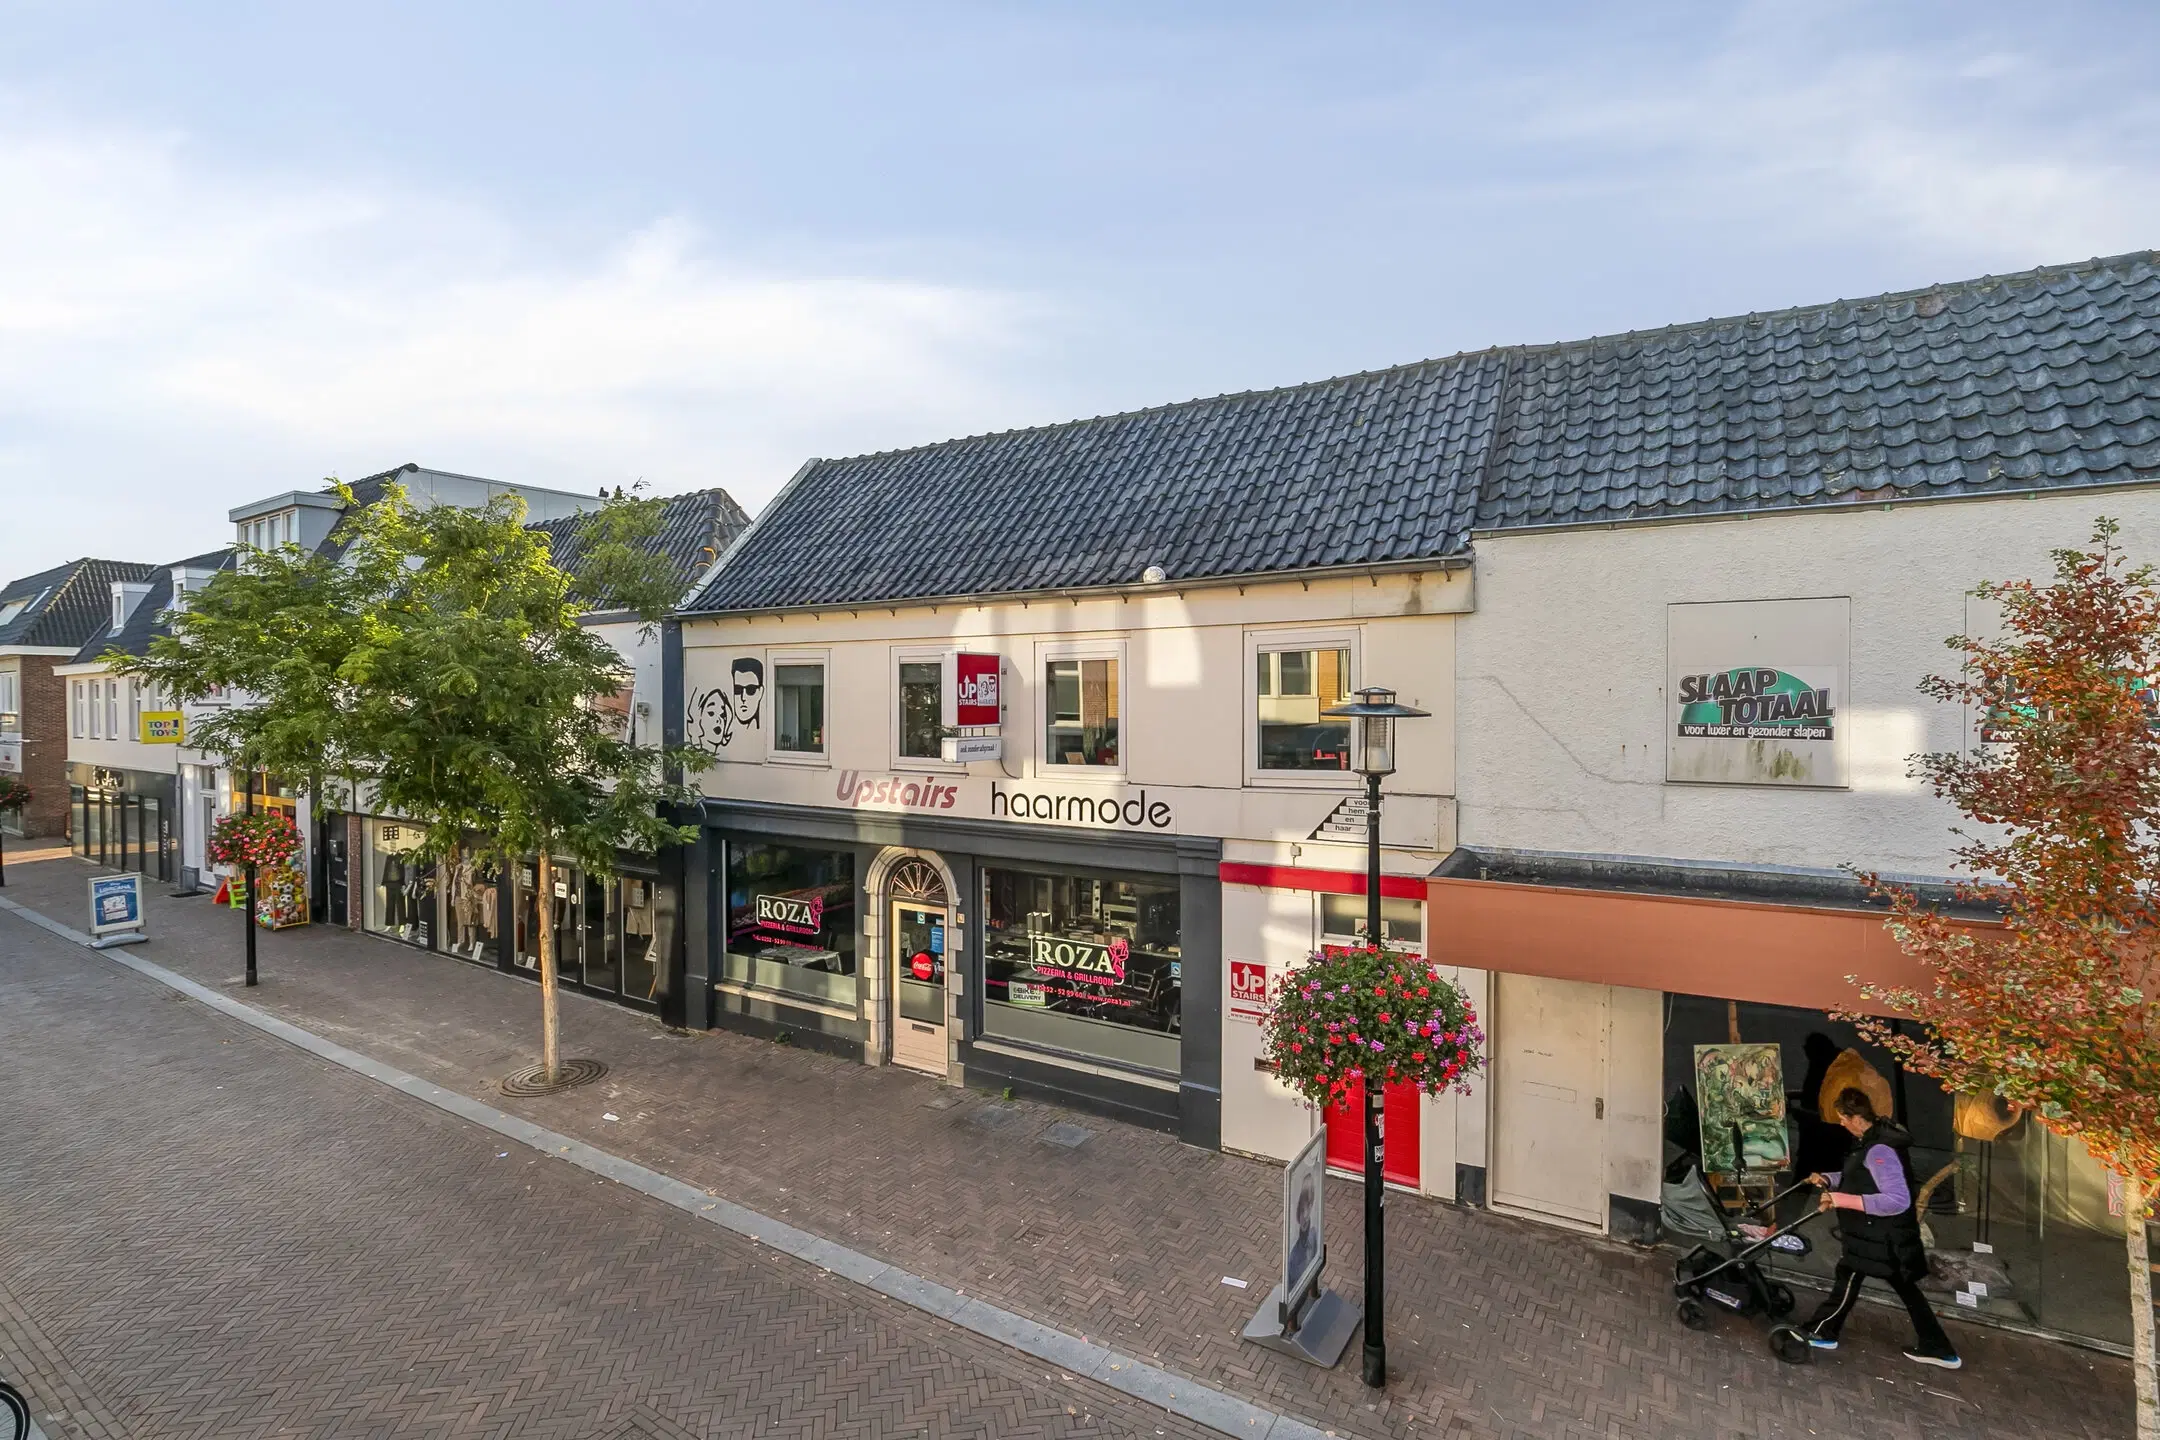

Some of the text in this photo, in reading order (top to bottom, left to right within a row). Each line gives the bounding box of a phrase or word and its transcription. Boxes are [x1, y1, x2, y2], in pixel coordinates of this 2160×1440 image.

[959, 678, 977, 699] UP
[1678, 668, 1779, 705] SLAAP
[959, 698, 977, 706] STAIRS
[1718, 688, 1835, 726] TOTAAL
[147, 720, 171, 728] TOP
[150, 729, 178, 737] TOYS
[1684, 723, 1826, 740] voor luxer en gezonder slapen
[836, 769, 1172, 828] Upstairs haarmode
[1348, 807, 1365, 815] hem
[759, 899, 815, 925] ROZA
[760, 920, 781, 930] PIZZERIA
[1035, 940, 1116, 975] ROZA
[1036, 966, 1115, 987] PIZZERIA & GRILLROOM
[1232, 968, 1265, 993] UP
[1057, 988, 1065, 996] 52
[1087, 993, 1131, 1008] www.roza1.nl
[1232, 990, 1265, 1002] STAIRS
